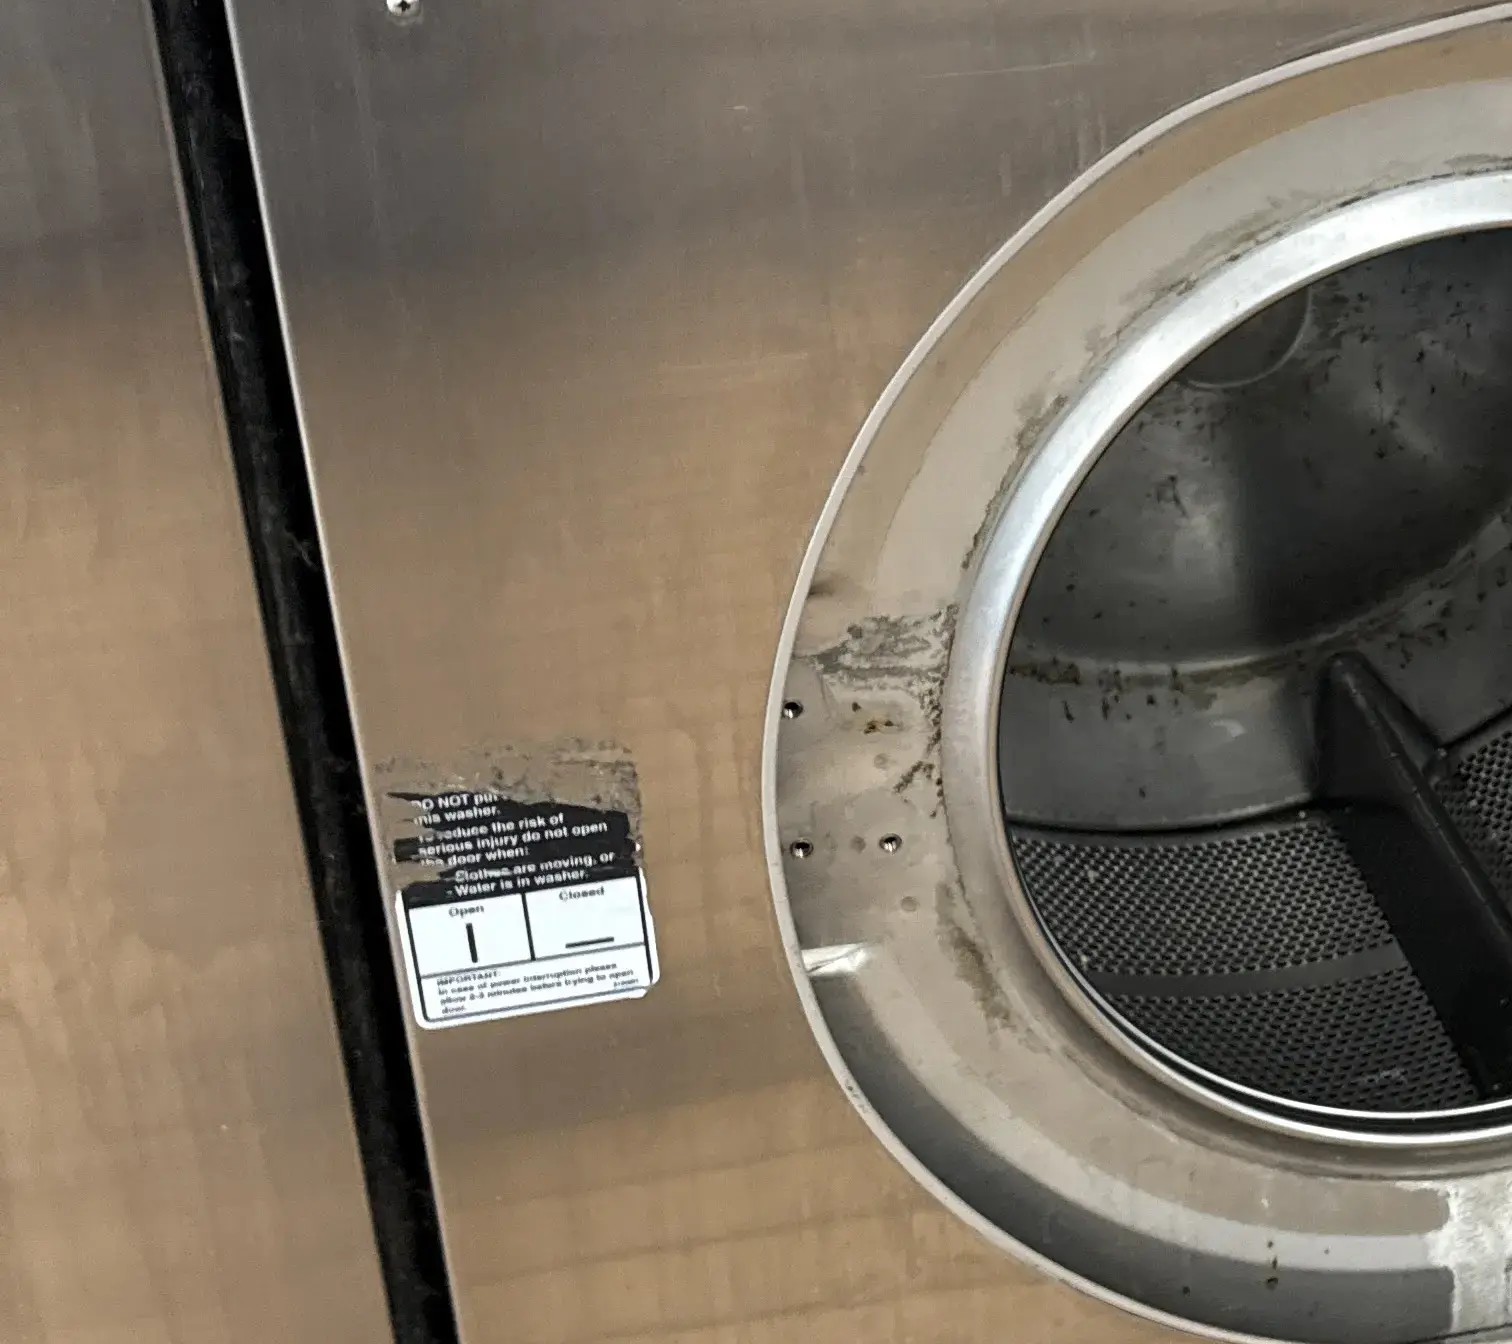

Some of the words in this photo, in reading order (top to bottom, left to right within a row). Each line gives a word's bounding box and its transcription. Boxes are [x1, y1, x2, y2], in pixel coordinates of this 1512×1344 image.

[438, 793, 469, 808] NOT
[444, 806, 500, 822] washer.
[491, 821, 515, 834] the
[518, 816, 545, 830] risk
[549, 812, 564, 826] of
[418, 841, 473, 856] serious
[476, 835, 518, 849] injury
[522, 830, 541, 843] do
[544, 826, 568, 840] not
[571, 822, 608, 837] open
[447, 853, 482, 867] door
[485, 846, 529, 862] when:
[513, 862, 536, 875] are
[599, 851, 615, 862] or
[454, 882, 496, 898] Water
[500, 878, 513, 890] is
[517, 876, 530, 888] in
[558, 885, 605, 902] Closed
[448, 905, 485, 918] Open
